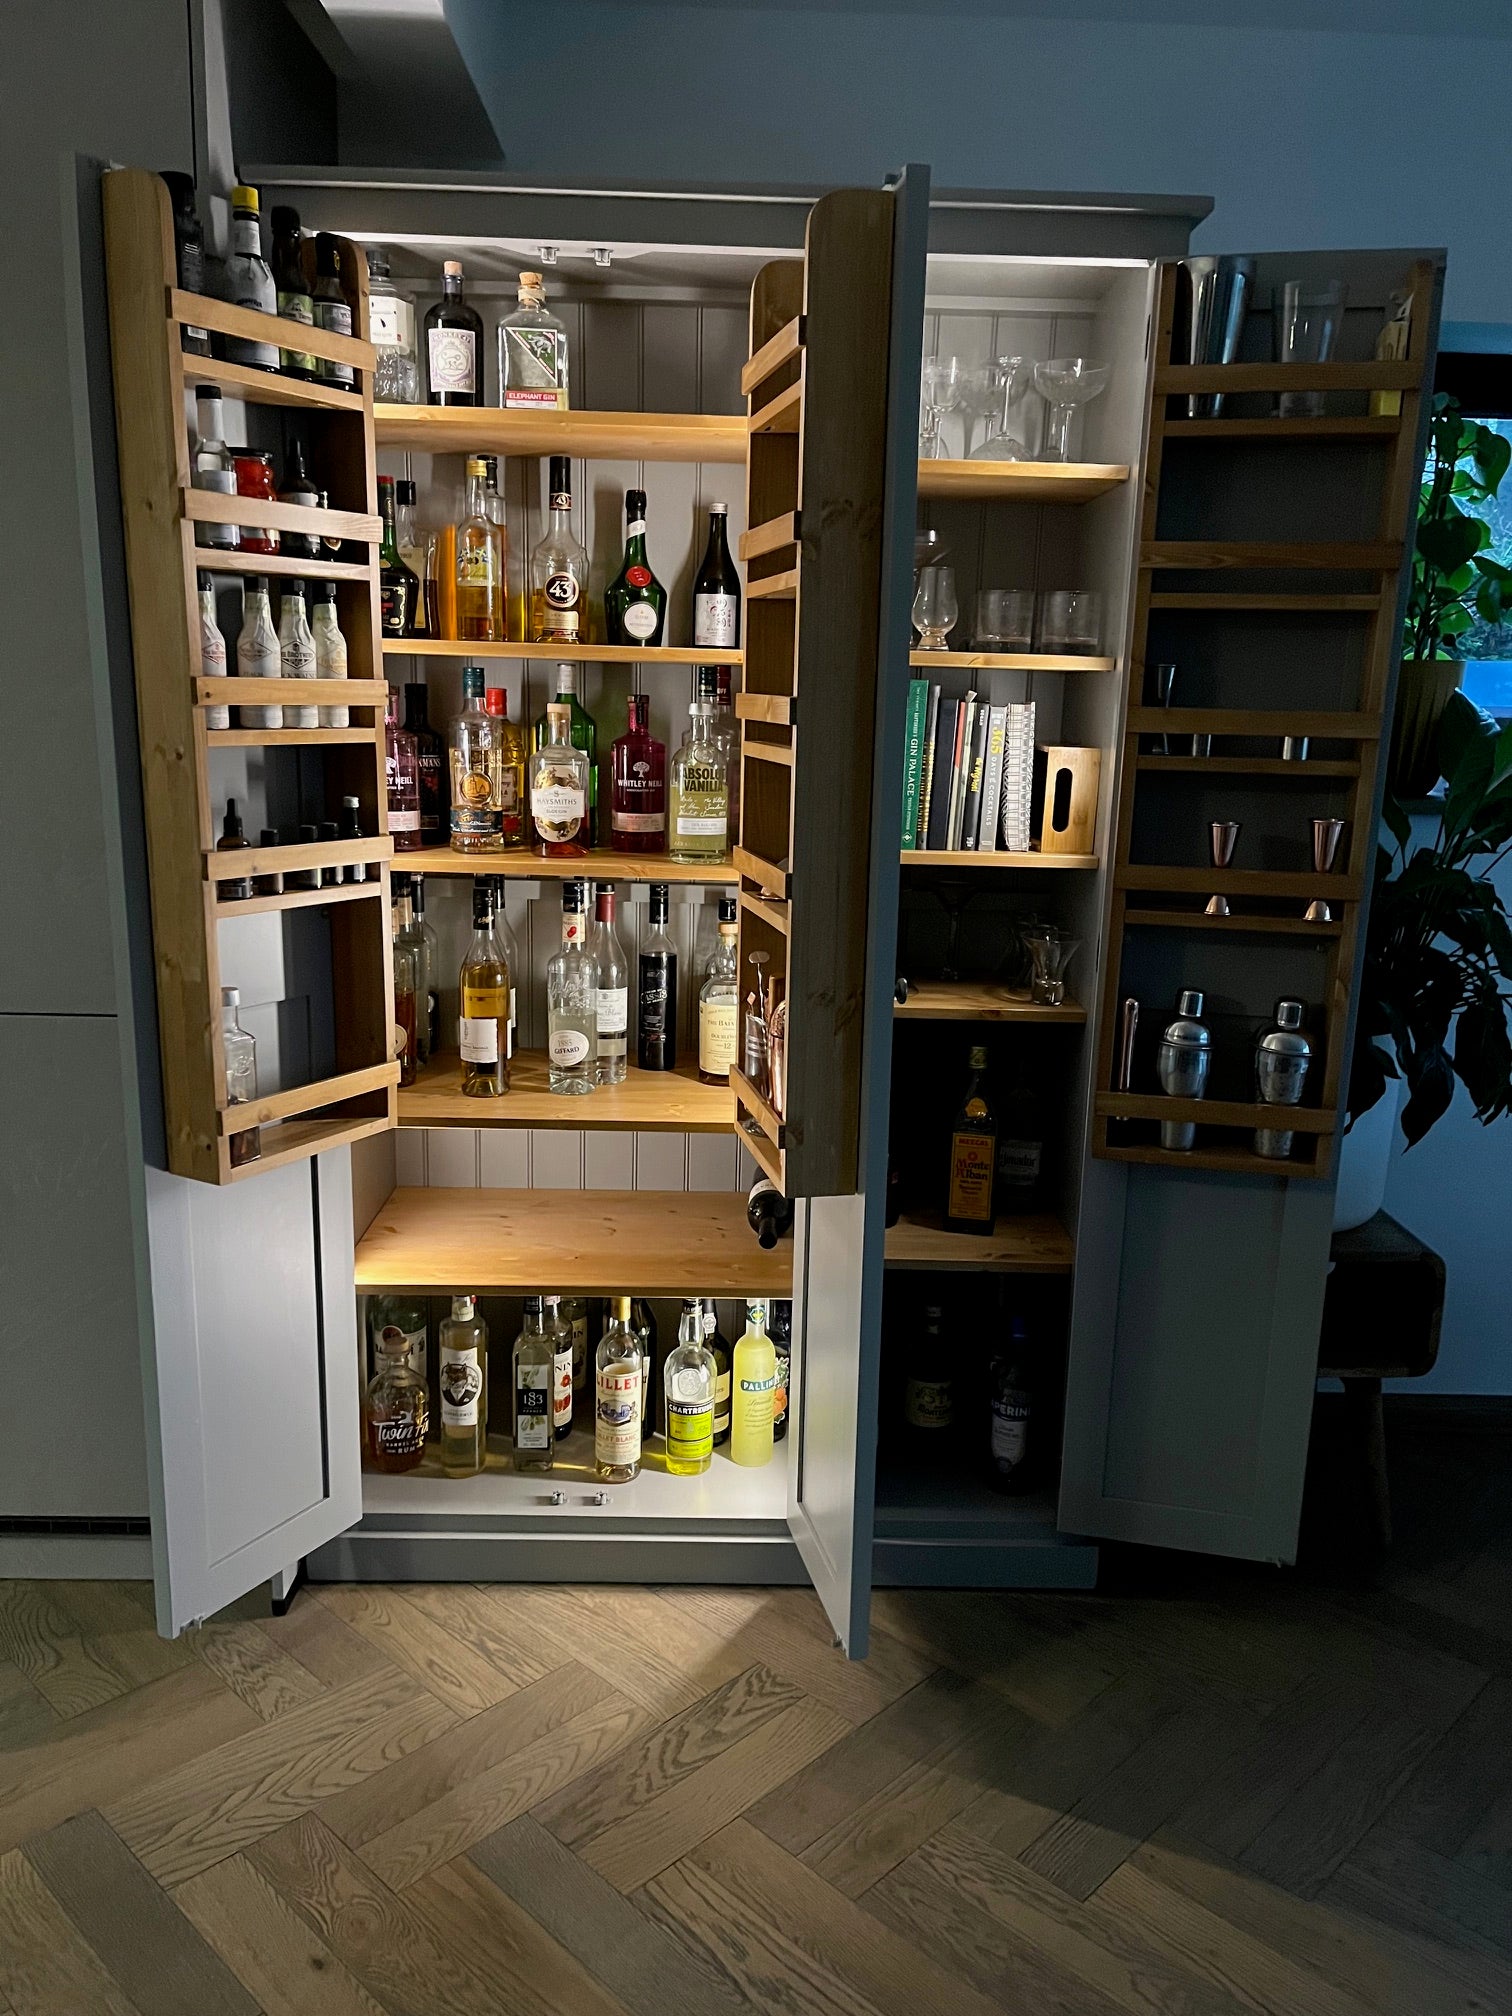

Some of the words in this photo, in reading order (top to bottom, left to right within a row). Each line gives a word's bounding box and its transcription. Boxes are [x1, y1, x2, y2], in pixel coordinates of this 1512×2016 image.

[508, 392, 543, 400] ELEPHANT
[543, 393, 556, 401] GIN
[549, 580, 572, 598] 43
[990, 727, 1004, 754] 365
[909, 738, 919, 756] GIN
[989, 757, 998, 776] DAYS
[617, 779, 647, 788] WHITLEY
[906, 759, 918, 797] PALACE
[536, 798, 577, 806] HAYSMITHS
[985, 785, 996, 826] COCKTAILS
[724, 1042, 732, 1050] 12
[957, 1159, 991, 1170] Monte
[957, 1168, 988, 1180] Alban
[668, 1403, 713, 1415] CHARTRE
[372, 1421, 414, 1442] Twin
[615, 1434, 637, 1443] BLANC
